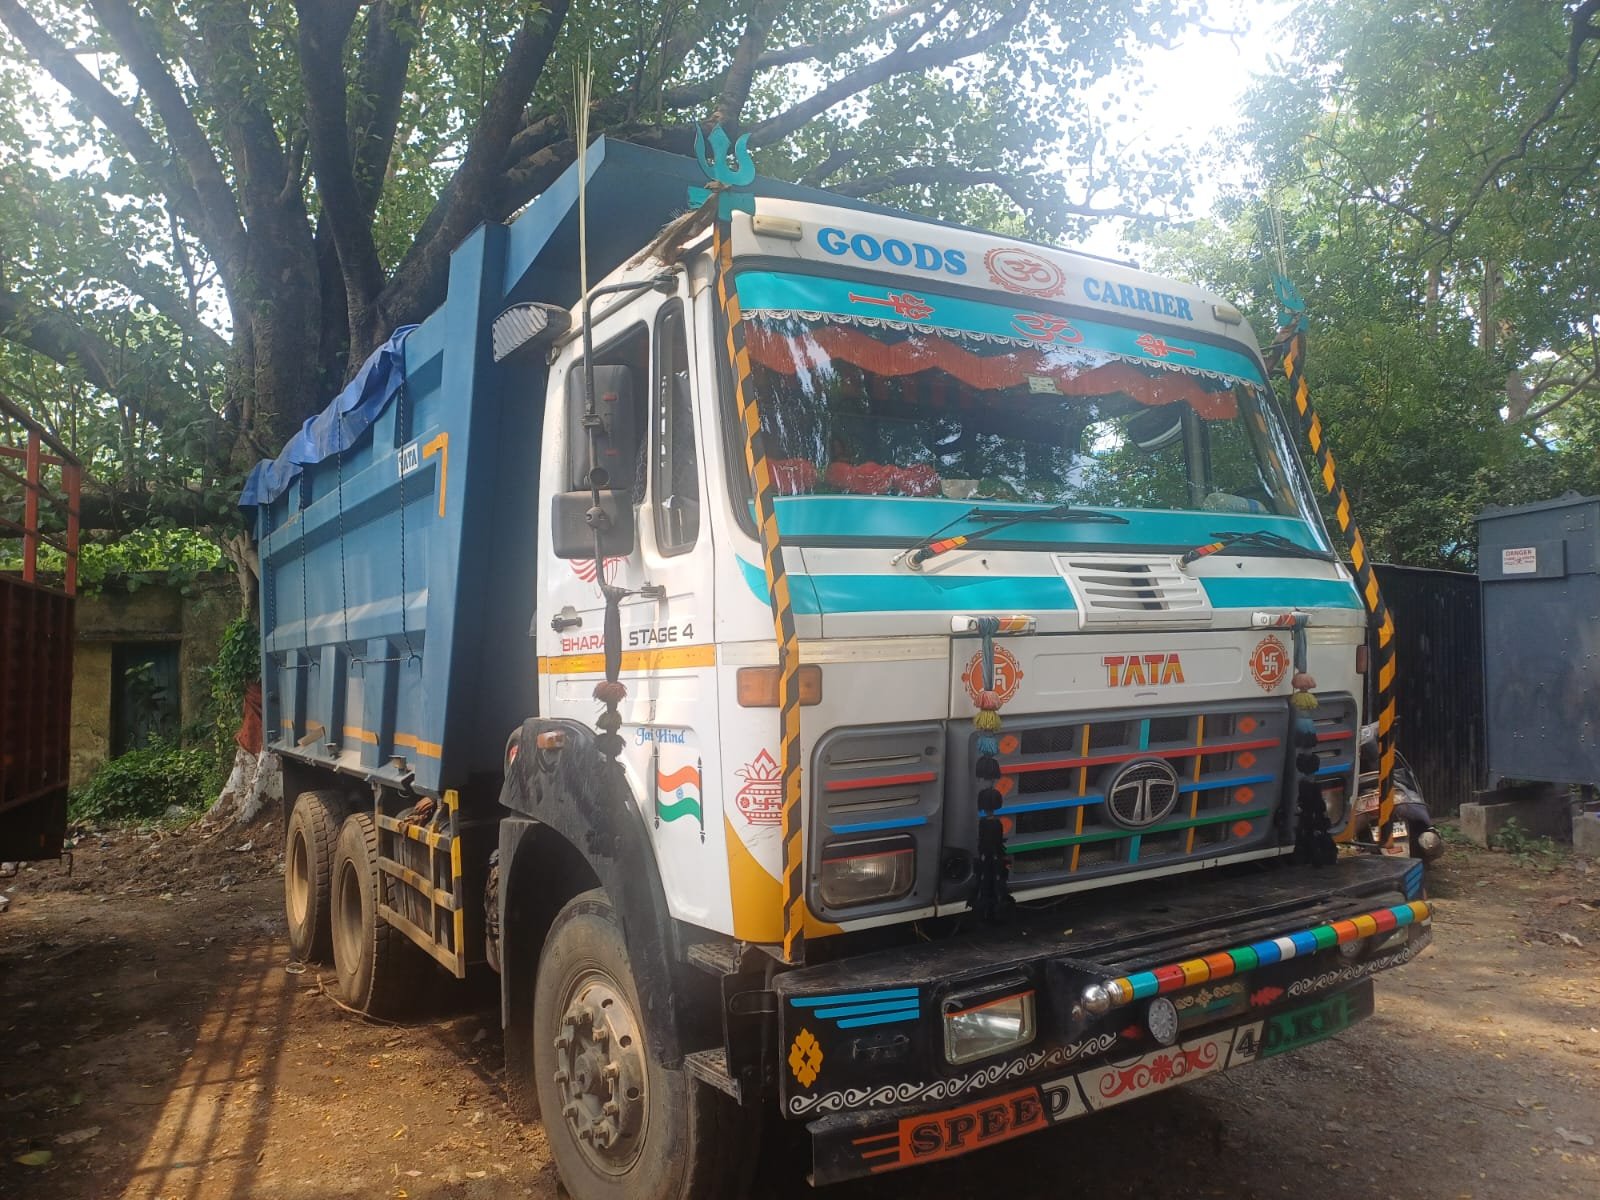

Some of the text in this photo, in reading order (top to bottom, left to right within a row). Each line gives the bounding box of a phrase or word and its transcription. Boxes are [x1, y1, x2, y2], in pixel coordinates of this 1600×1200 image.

[817, 227, 1194, 321] GOODS CARRIER
[562, 623, 694, 652] BHARA STAGE 4
[1101, 653, 1185, 687] TATA
[635, 727, 685, 746] Jai Hind
[909, 1084, 1071, 1157] SPEED
